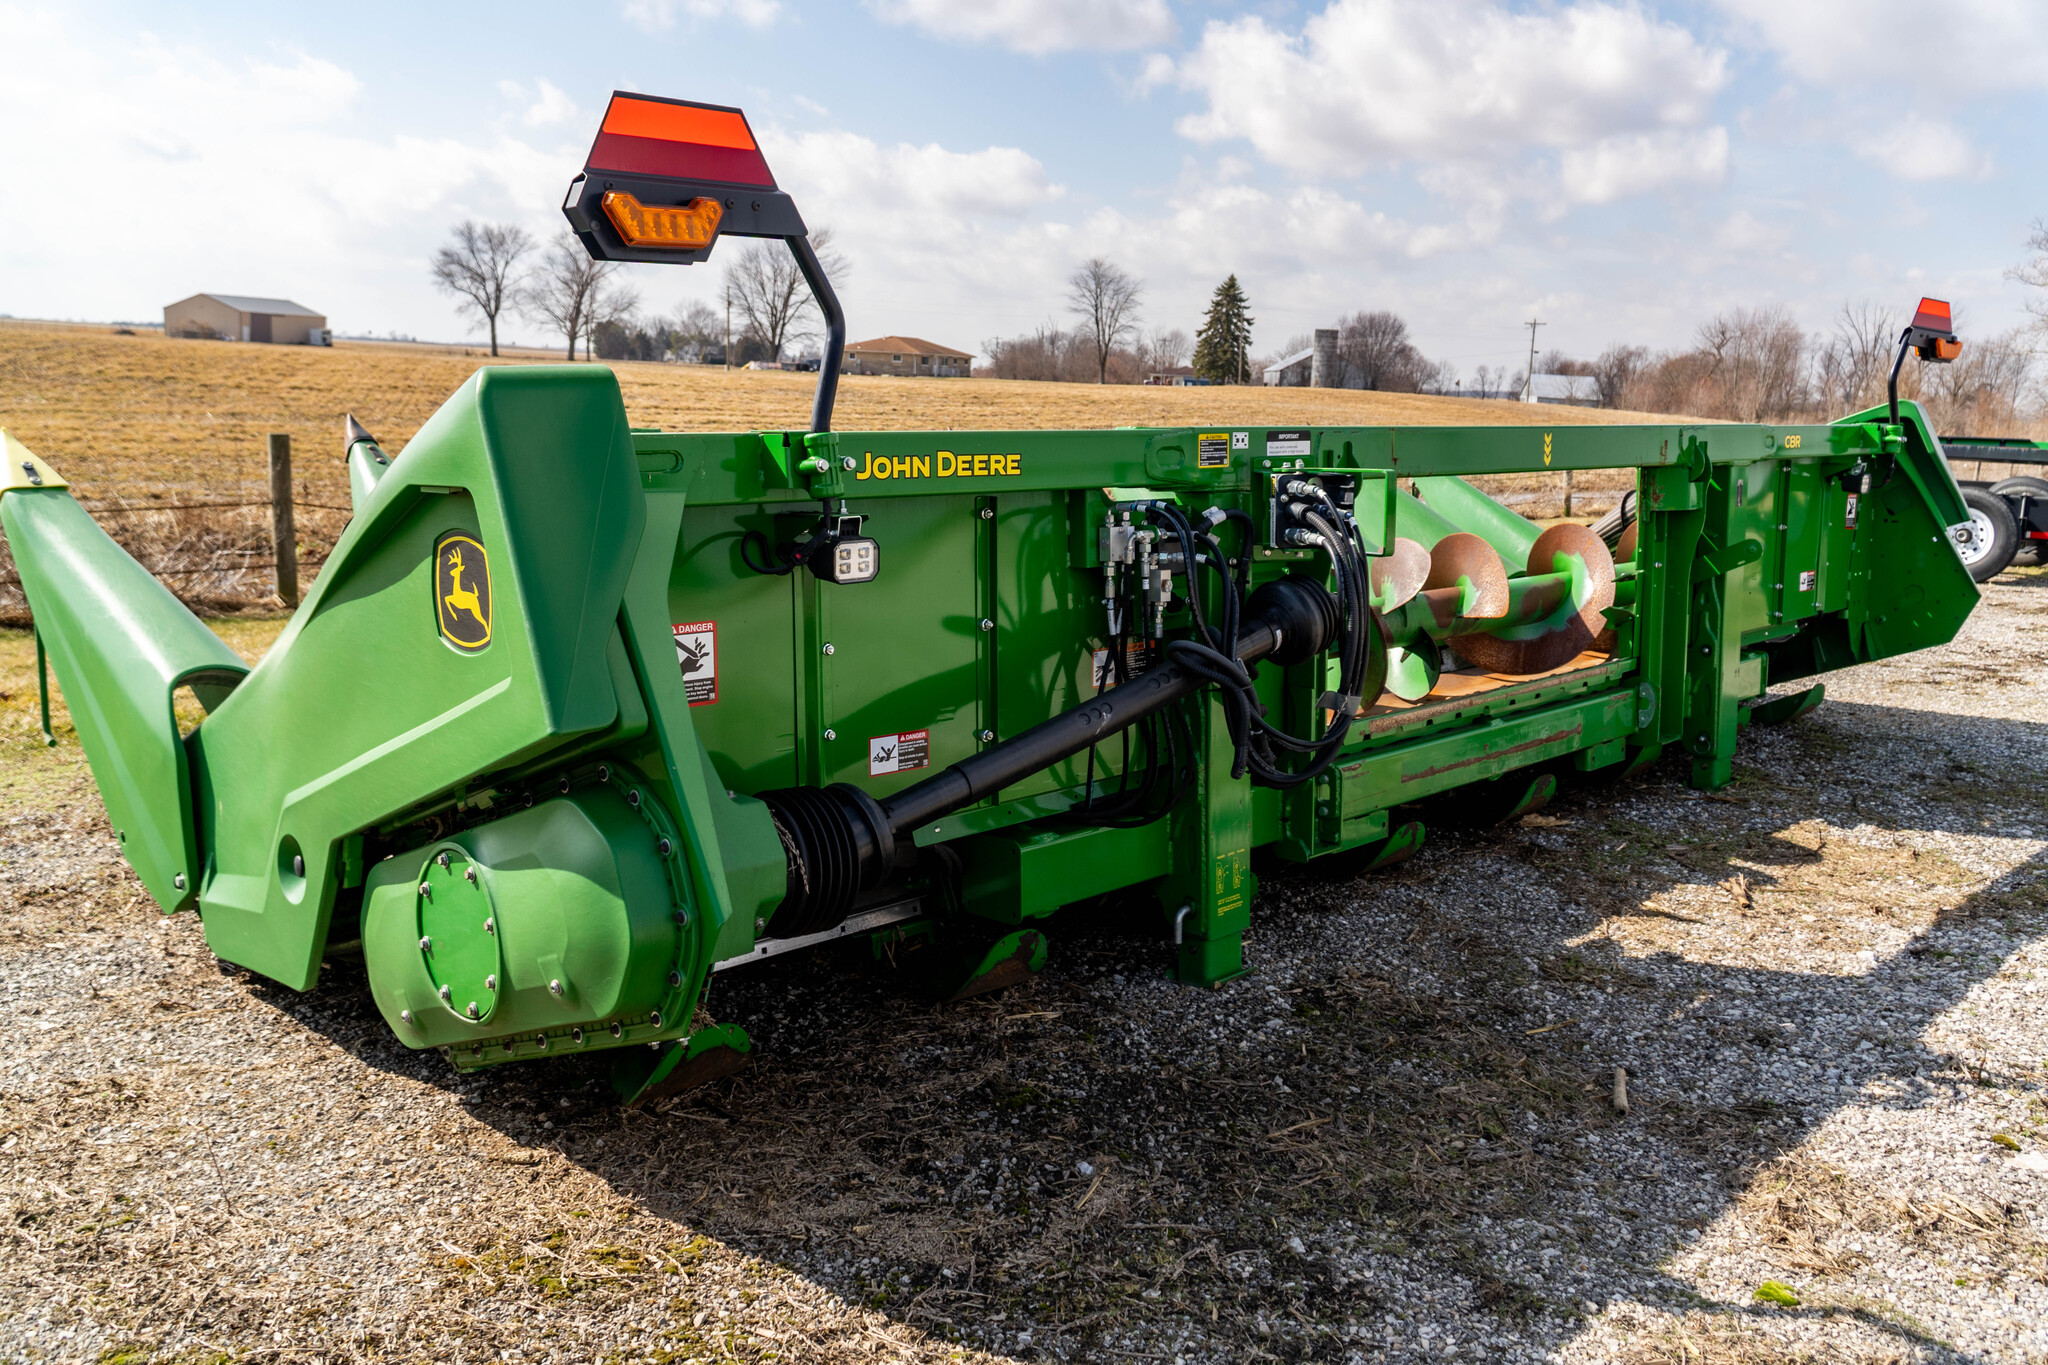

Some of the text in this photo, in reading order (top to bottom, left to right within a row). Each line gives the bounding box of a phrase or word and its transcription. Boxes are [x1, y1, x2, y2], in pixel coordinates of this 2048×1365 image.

[1785, 435, 1801, 448] C8R
[856, 450, 1021, 480] JOHN DEERE
[679, 623, 713, 633] DANGER
[905, 732, 926, 740] DANGER
